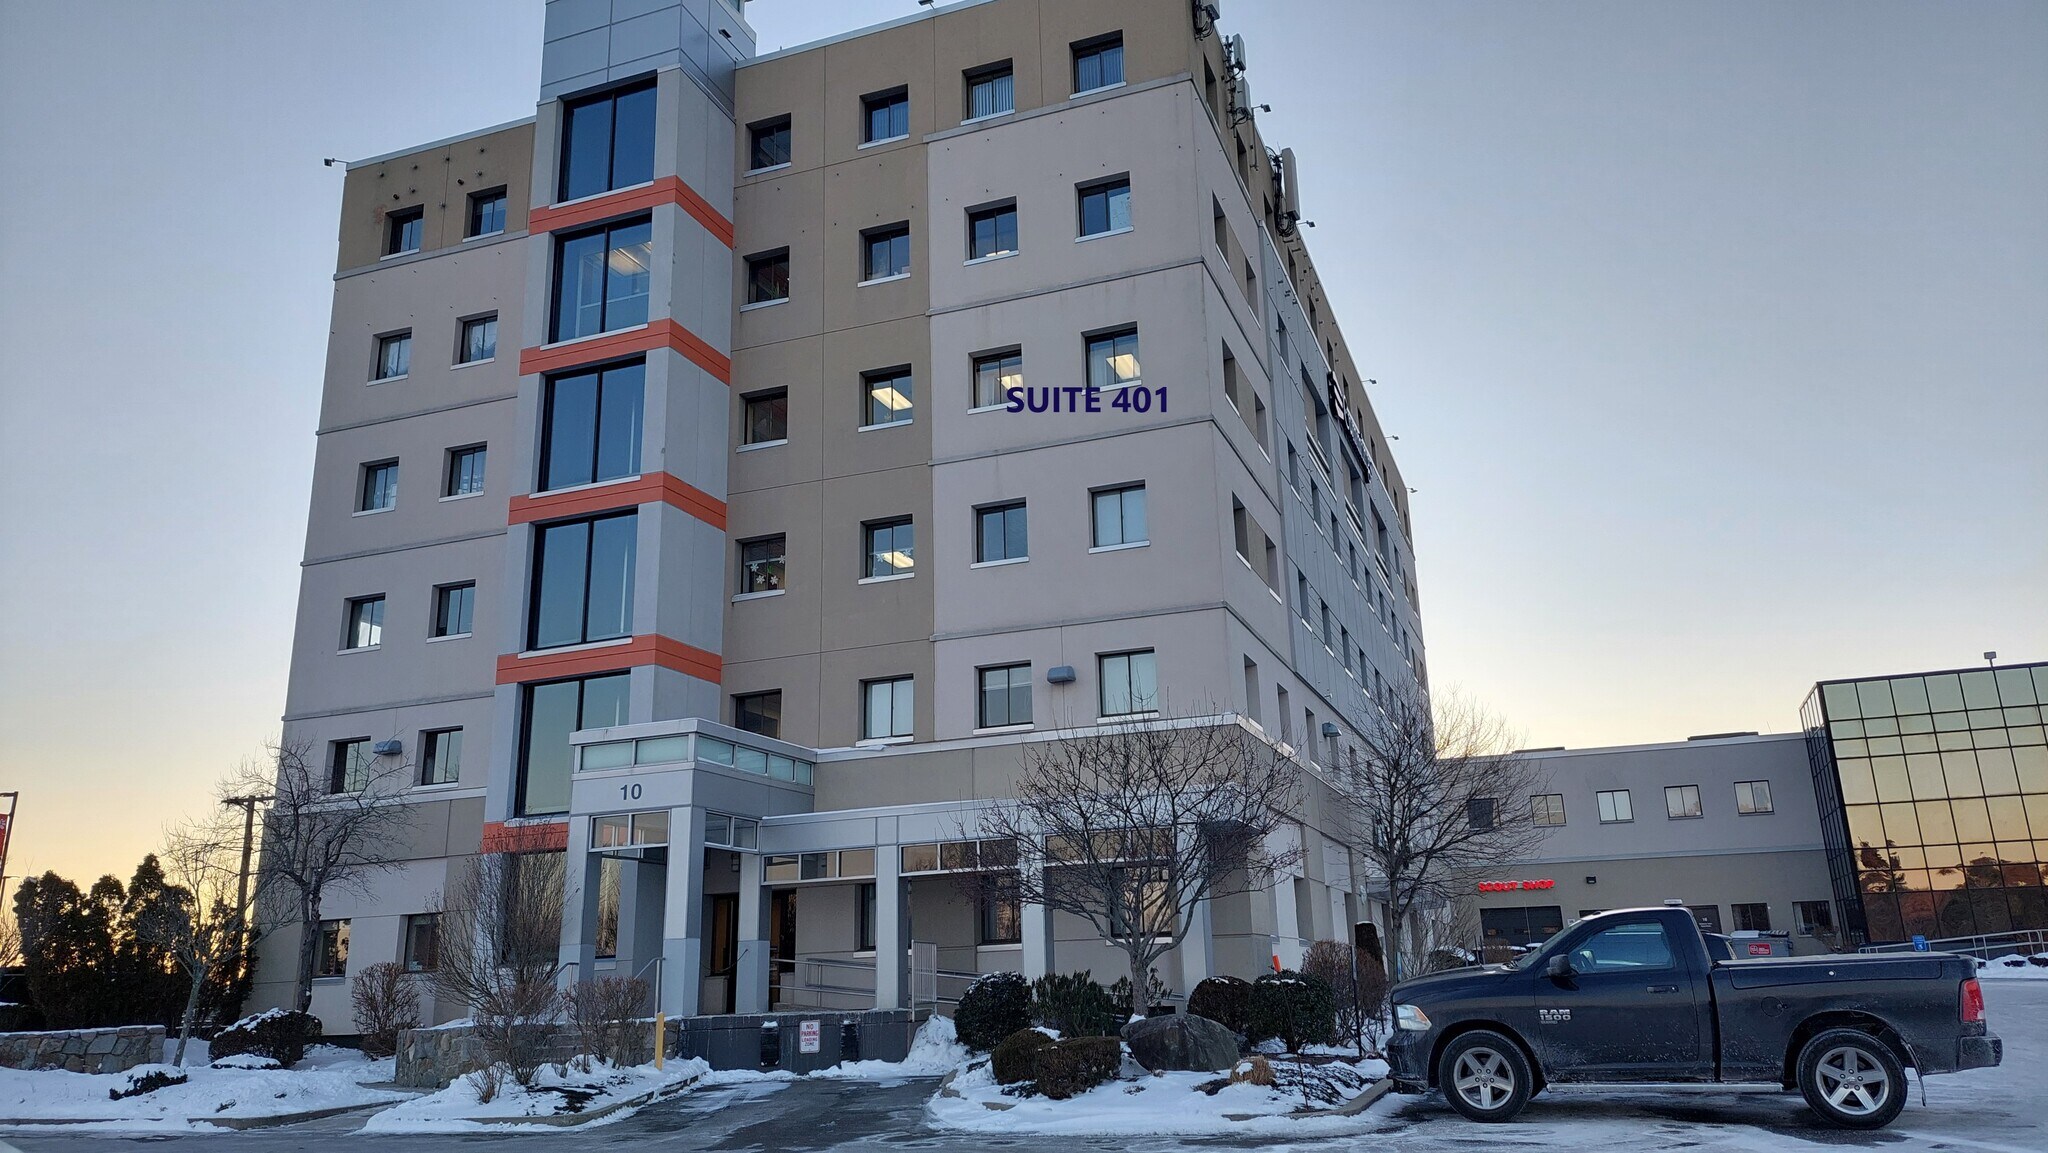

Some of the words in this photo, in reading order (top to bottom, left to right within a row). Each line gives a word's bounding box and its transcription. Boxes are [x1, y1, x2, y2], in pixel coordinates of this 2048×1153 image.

[620, 783, 643, 801] 10
[1478, 880, 1518, 892] SCOUT
[1522, 879, 1555, 891] SHOP
